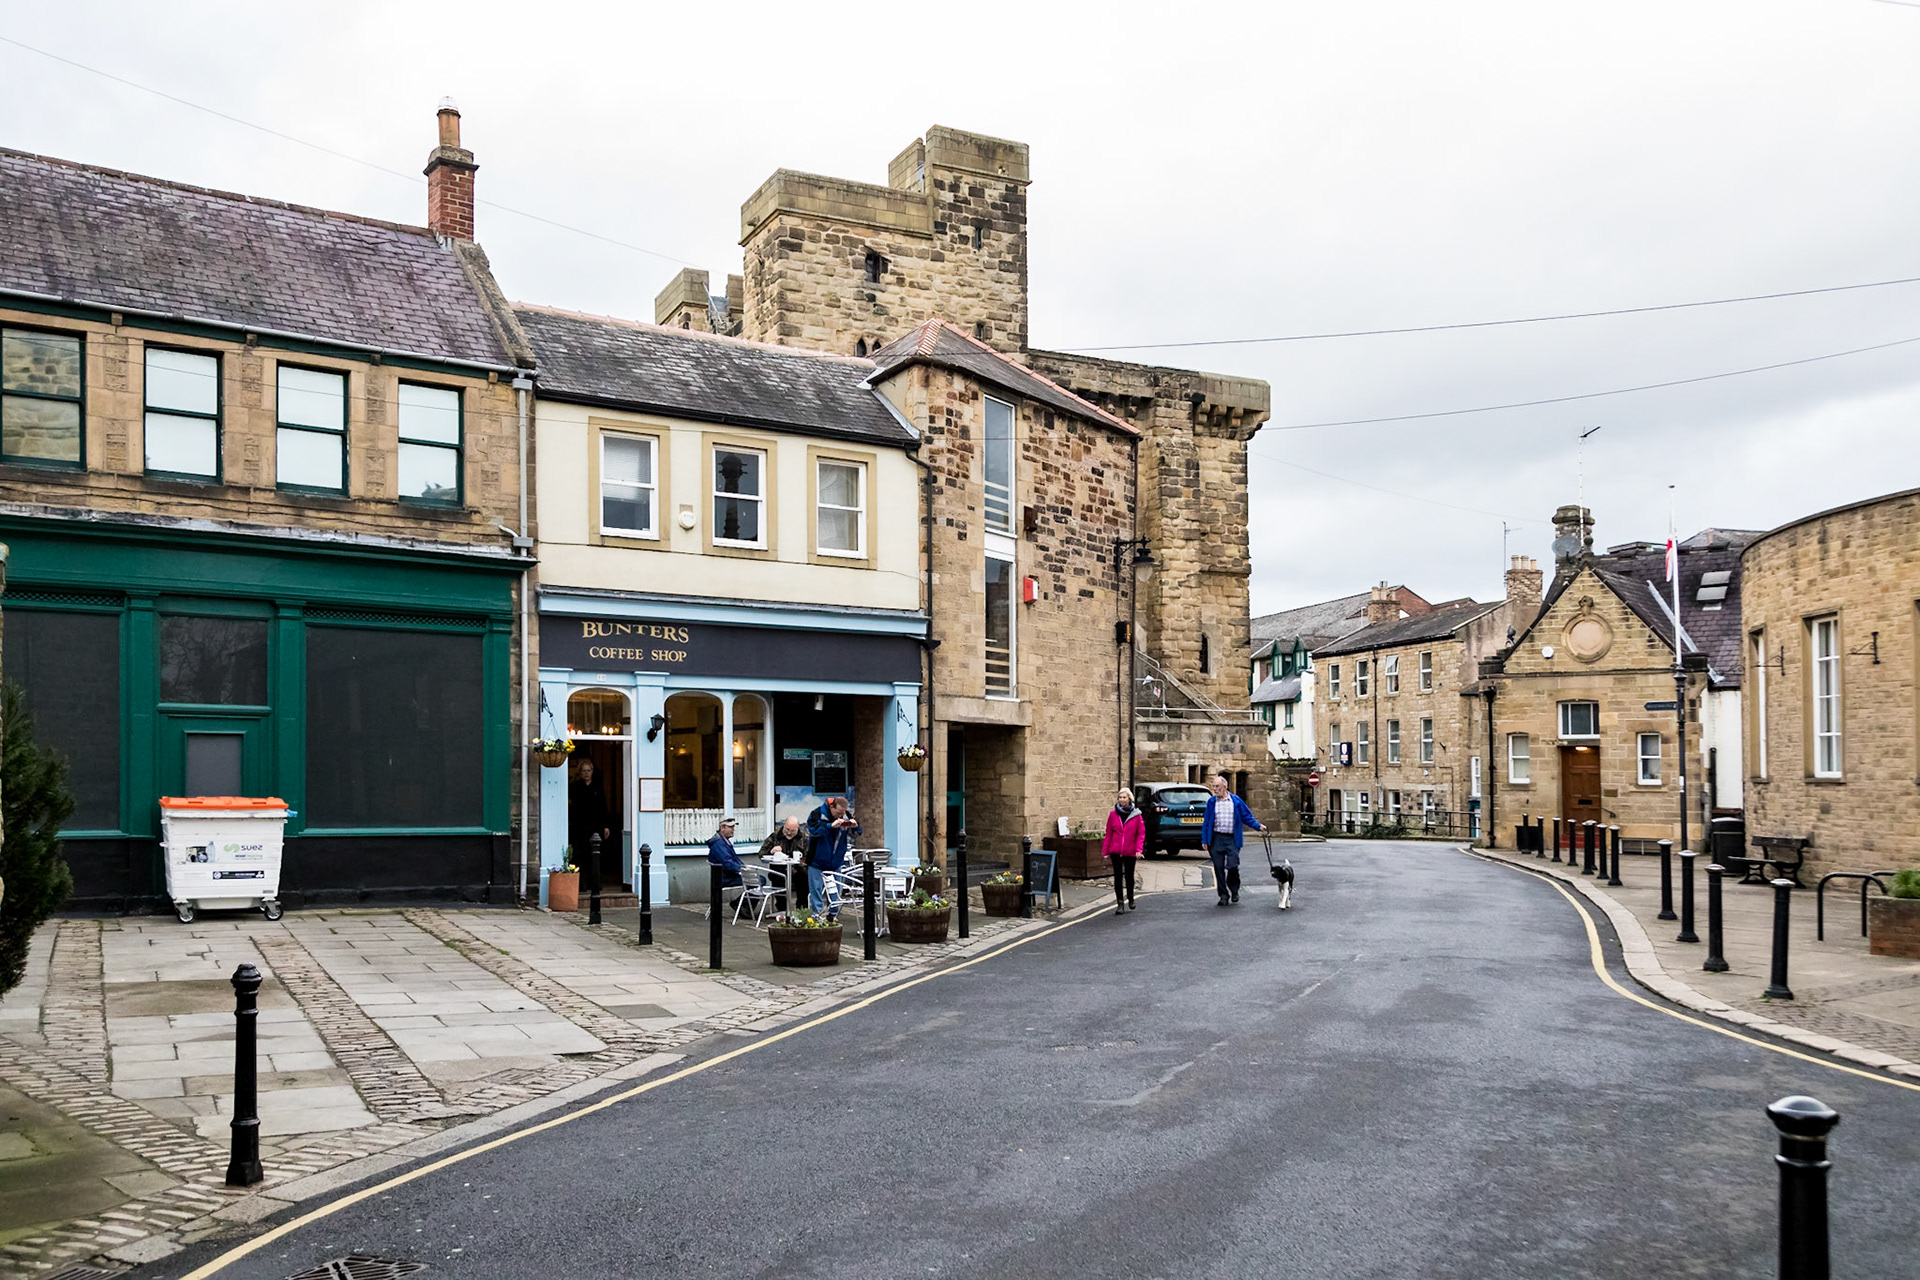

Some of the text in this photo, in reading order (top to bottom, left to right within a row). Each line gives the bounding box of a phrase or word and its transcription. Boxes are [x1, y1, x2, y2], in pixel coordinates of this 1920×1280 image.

[581, 621, 689, 644] BUNTERS
[589, 646, 687, 662] COFFEE SHOP
